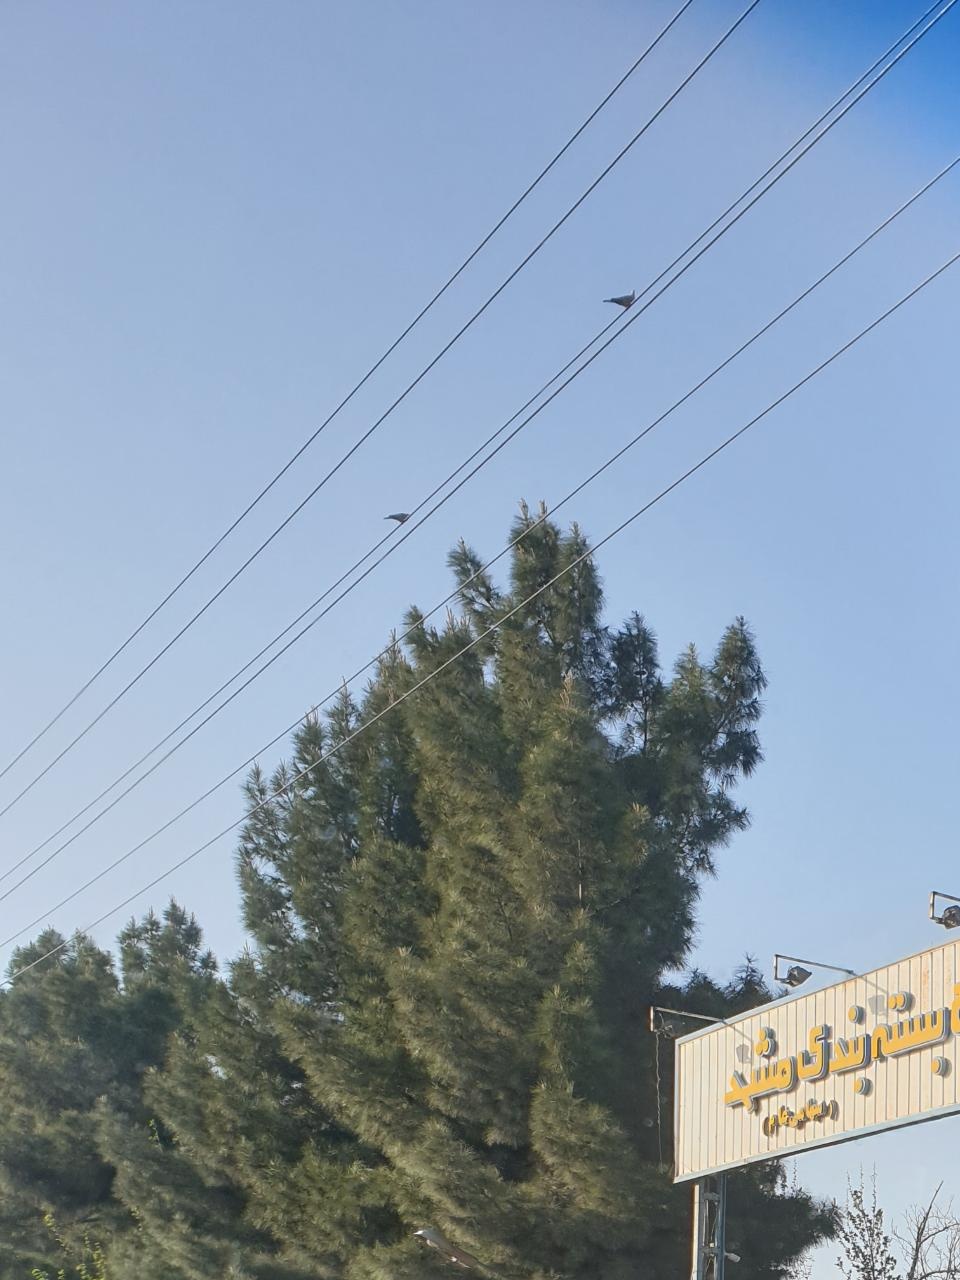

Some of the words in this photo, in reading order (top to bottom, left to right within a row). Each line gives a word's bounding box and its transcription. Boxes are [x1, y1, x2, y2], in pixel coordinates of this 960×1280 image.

[724, 1026, 796, 1113] مشهد
[797, 1005, 872, 1095] بندی
[870, 991, 951, 1077] بسته
